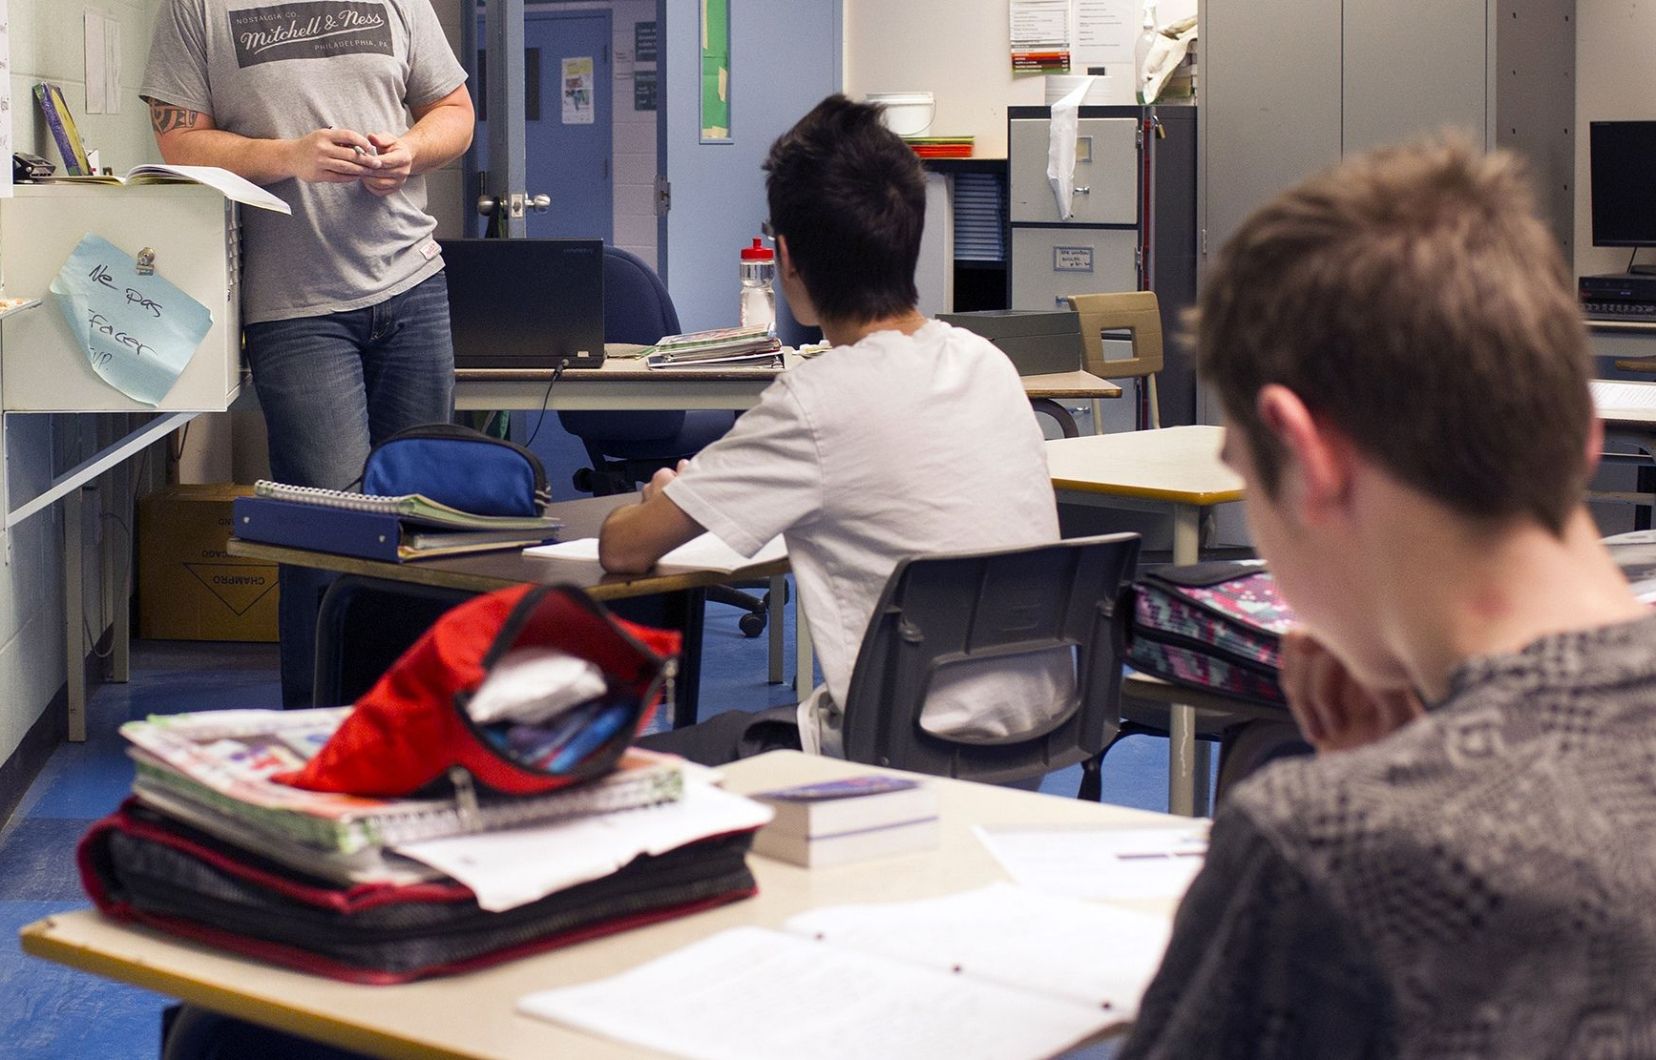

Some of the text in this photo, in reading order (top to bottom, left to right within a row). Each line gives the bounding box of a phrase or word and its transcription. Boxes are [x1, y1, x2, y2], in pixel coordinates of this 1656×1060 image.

[236, 14, 282, 25] NOSTALGIA
[240, 9, 384, 50] Mitchell & Ness
[88, 264, 119, 291] Ne
[212, 575, 266, 586] CHAMPRO
